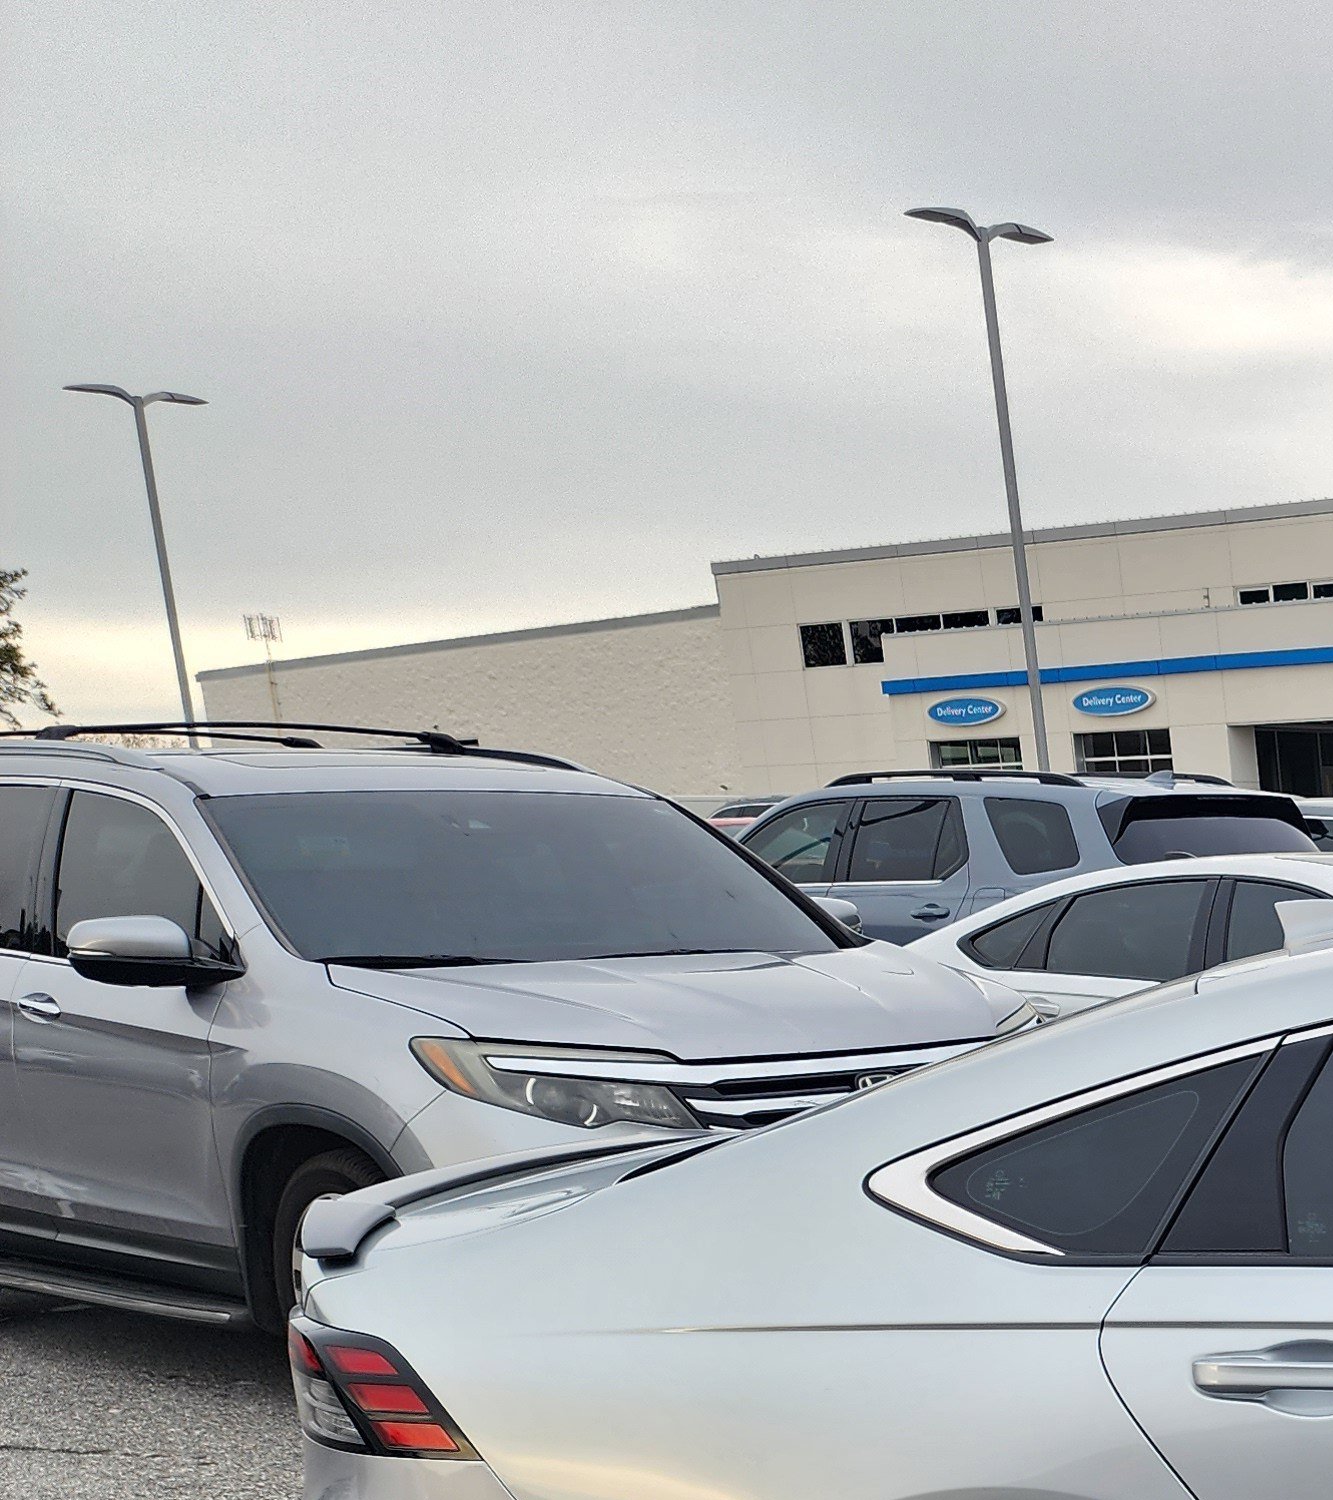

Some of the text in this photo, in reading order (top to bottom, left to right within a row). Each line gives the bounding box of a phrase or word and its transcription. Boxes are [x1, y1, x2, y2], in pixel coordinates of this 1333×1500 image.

[1082, 694, 1142, 707] Delivery Center
[936, 705, 993, 717] Delivery Center
